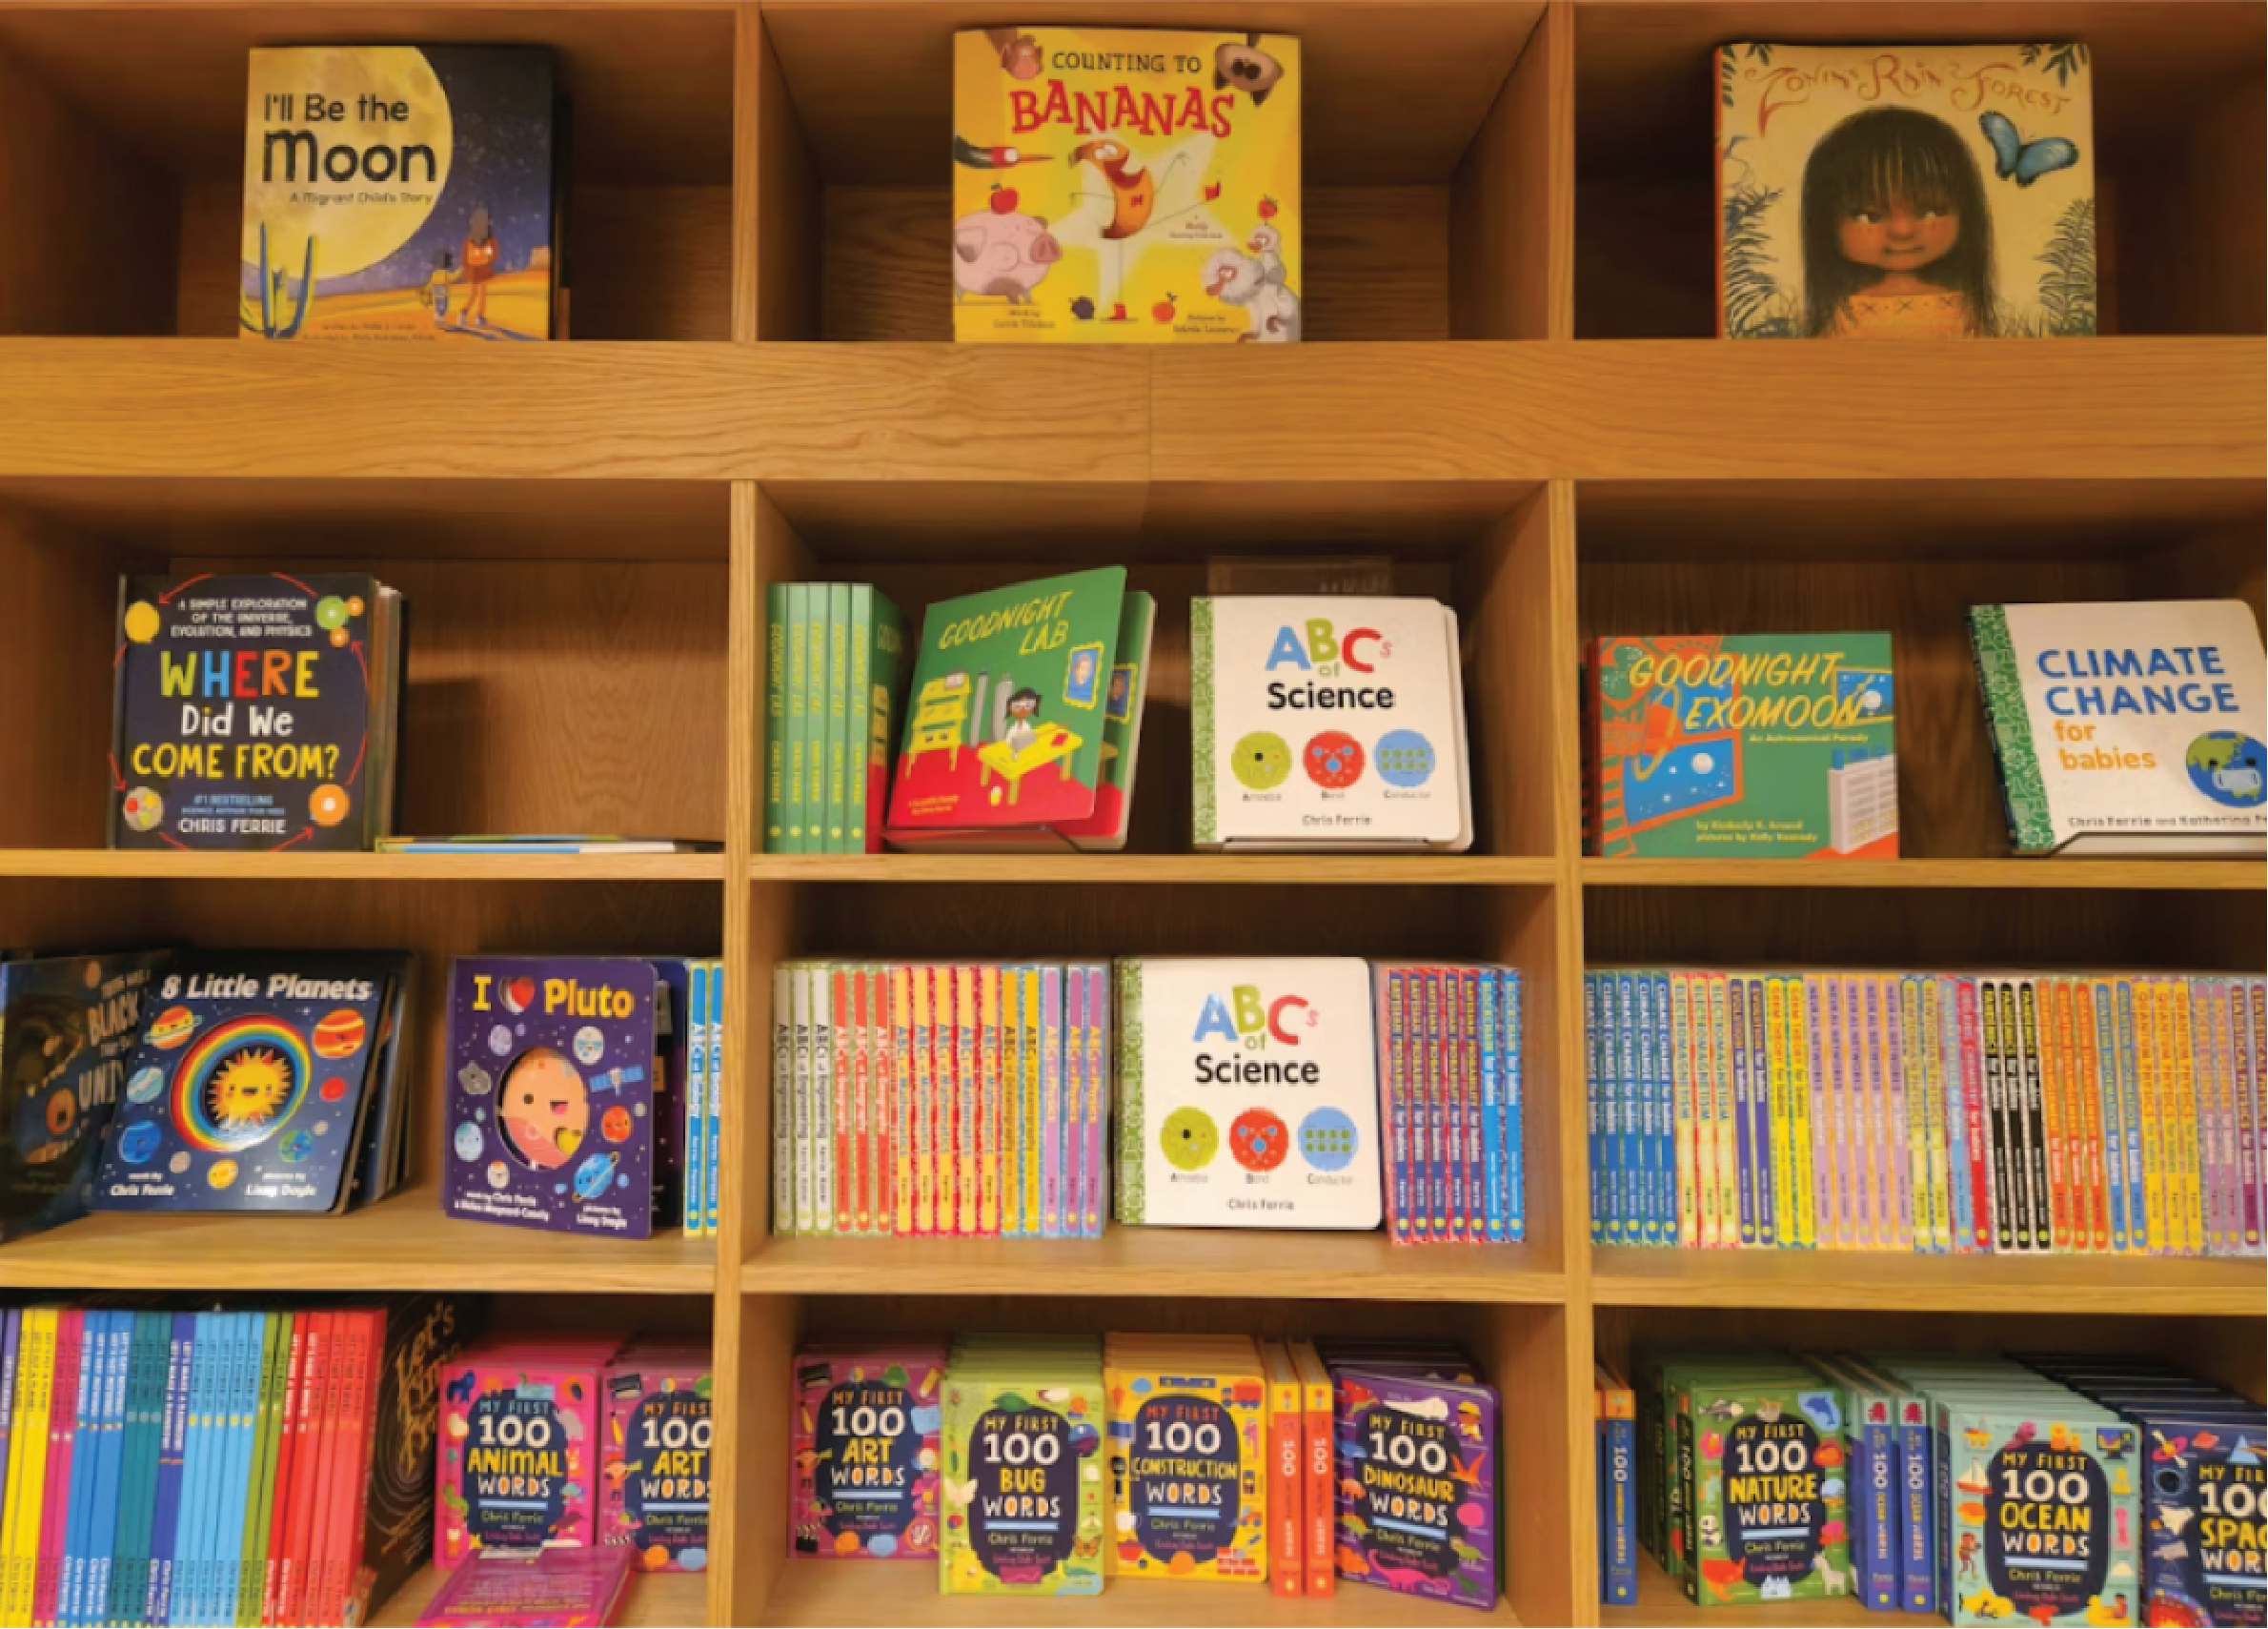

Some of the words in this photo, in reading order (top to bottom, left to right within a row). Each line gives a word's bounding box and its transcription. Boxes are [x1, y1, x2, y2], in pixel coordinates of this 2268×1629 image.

[1052, 52, 1165, 72] COUNTING
[1173, 54, 1202, 73] TO
[264, 93, 294, 121] I'll
[305, 93, 345, 121] Be
[357, 93, 409, 121] the
[1010, 79, 1234, 138] BANANAS
[262, 130, 436, 182] Moon
[290, 193, 298, 202] A
[303, 193, 354, 205] Migrant
[357, 193, 397, 203] Child's
[400, 193, 434, 204] Story
[189, 598, 228, 610] SIMPLE
[230, 598, 308, 610] EXPLORATION
[192, 613, 208, 624] OF
[212, 613, 233, 624] THE
[238, 625, 263, 638] AND
[264, 625, 313, 638] PHYSICS
[938, 590, 1074, 650] GOODNIGHT
[1019, 621, 1069, 656] LAB
[160, 649, 320, 699] WHERE
[1319, 662, 1340, 677] of
[1629, 651, 1845, 686] GOODNIGHT
[2035, 645, 2225, 679] CLIMATE
[1266, 681, 1396, 709] Science
[2045, 683, 2239, 716] CHANGE
[180, 702, 234, 737] Did
[249, 705, 294, 737] We
[1685, 692, 1865, 729] EXOMOON
[2054, 719, 2096, 742] for
[132, 743, 225, 779] COME
[235, 743, 340, 780] FROM?
[2057, 746, 2157, 770] babies
[177, 818, 226, 833] CHRIS
[230, 818, 287, 833] FERRIE
[1302, 815, 1333, 826] Chris
[1336, 815, 1372, 826] Ferrie
[1696, 821, 1709, 831] by
[2069, 816, 2105, 826] Chris
[2107, 815, 2152, 826] Ferrie
[2156, 815, 2176, 825] and
[1735, 833, 1747, 844] by
[161, 973, 182, 1000] 8
[186, 973, 260, 1000] Little
[266, 973, 375, 1001] Planets
[473, 974, 492, 1011] I
[543, 978, 635, 1018] Pluto
[1245, 1033, 1267, 1050] of
[1195, 1053, 1320, 1085] Science
[815, 1074, 829, 1139] Engineering
[1089, 1076, 1103, 1123] Physics
[110, 1184, 139, 1196] Chris
[141, 1184, 175, 1196] Ferrie
[281, 1184, 316, 1198] Doyle
[1226, 1198, 1258, 1210] Chris
[1260, 1199, 1295, 1211] Ferrie
[479, 1400, 502, 1415] MY
[509, 1400, 550, 1415] FIRST
[642, 1401, 664, 1415] MY
[832, 1390, 855, 1405] MY
[861, 1390, 903, 1405] FIRST
[831, 1407, 905, 1436] 100
[983, 1415, 1005, 1431] MY
[1015, 1415, 1059, 1432] FIRST
[1146, 1405, 1168, 1419] MY
[1174, 1405, 1220, 1420] FIRST
[478, 1415, 552, 1447] 100
[1144, 1421, 1222, 1455] 100
[1368, 1414, 1391, 1428] MY
[1401, 1420, 1447, 1439] FIRST
[1735, 1425, 1756, 1439] MY
[1764, 1423, 1805, 1438] FIRST
[468, 1447, 563, 1476] ANIMAL
[841, 1437, 894, 1464] ART
[982, 1433, 1061, 1465] 100
[1282, 1439, 1297, 1477] 100
[1367, 1433, 1448, 1474] 100
[1735, 1440, 1809, 1473] 100
[2002, 1451, 2028, 1465] MY
[2036, 1454, 2087, 1471] FIRST
[651, 1450, 708, 1477] ART
[1131, 1456, 1238, 1480] CONSTRUCTION
[1613, 1446, 1628, 1482] 100
[1873, 1454, 1887, 1489] 100
[2198, 1464, 2225, 1480] MY
[478, 1476, 551, 1498] WORDS
[831, 1467, 905, 1487] WORDS
[1001, 1468, 1046, 1493] BUG
[1364, 1465, 1455, 1503] DINOSAUR
[1730, 1475, 1819, 1504] NATURE
[2001, 1470, 2090, 1504] 100
[982, 1496, 1063, 1517] WORDS
[1145, 1483, 1223, 1505] WORDS
[1368, 1494, 1448, 1527] WORDS
[1738, 1503, 1812, 1526] WORDS
[2000, 1501, 2091, 1532] OCEAN
[988, 1533, 1018, 1545] Chris
[1022, 1533, 1054, 1545] Ferrie
[1745, 1541, 1772, 1554] Chris
[1774, 1540, 1806, 1552] Ferrie
[2003, 1532, 2091, 1558] WORDS
[2200, 1548, 2267, 1575] WOR
[2008, 1568, 2041, 1581] Chris
[2044, 1571, 2081, 1584] Ferrie
